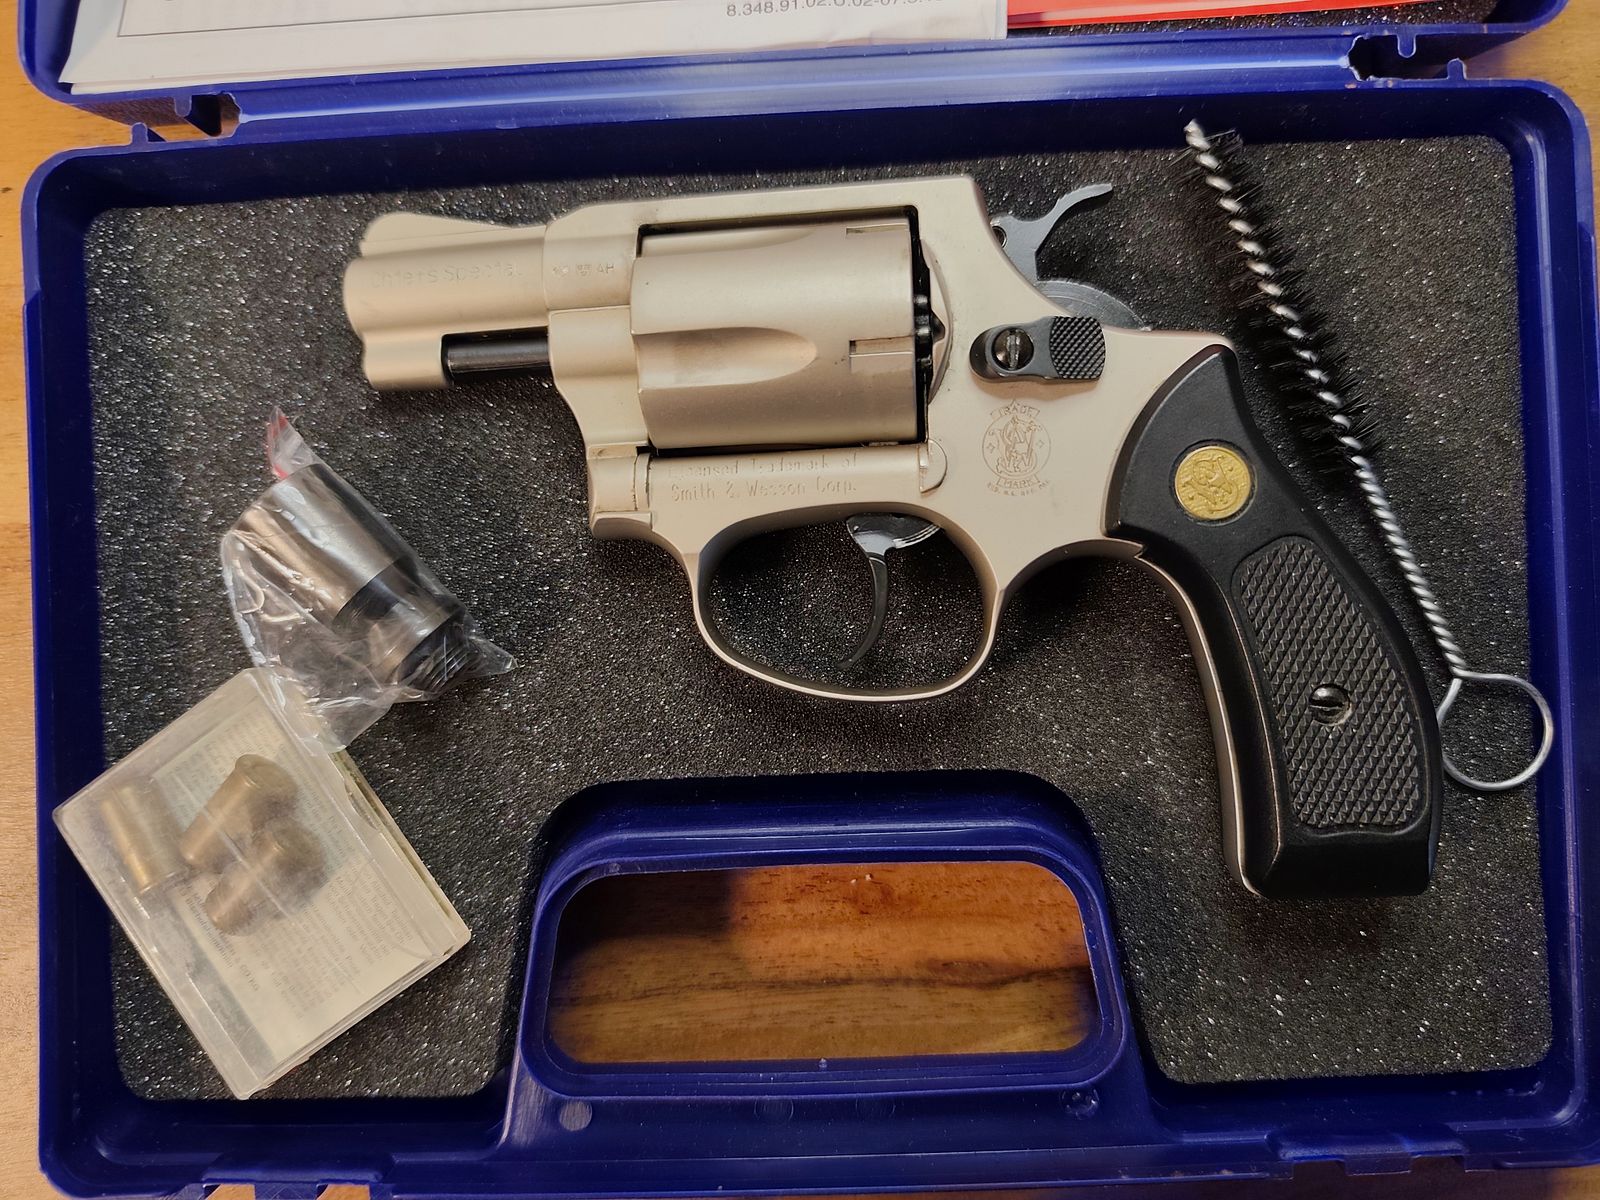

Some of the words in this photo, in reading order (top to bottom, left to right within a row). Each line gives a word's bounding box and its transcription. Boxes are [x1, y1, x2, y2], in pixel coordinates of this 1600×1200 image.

[671, 483, 715, 501] Smith
[726, 480, 740, 498] &
[747, 479, 806, 497] Wesson
[816, 476, 857, 495] Corp.
